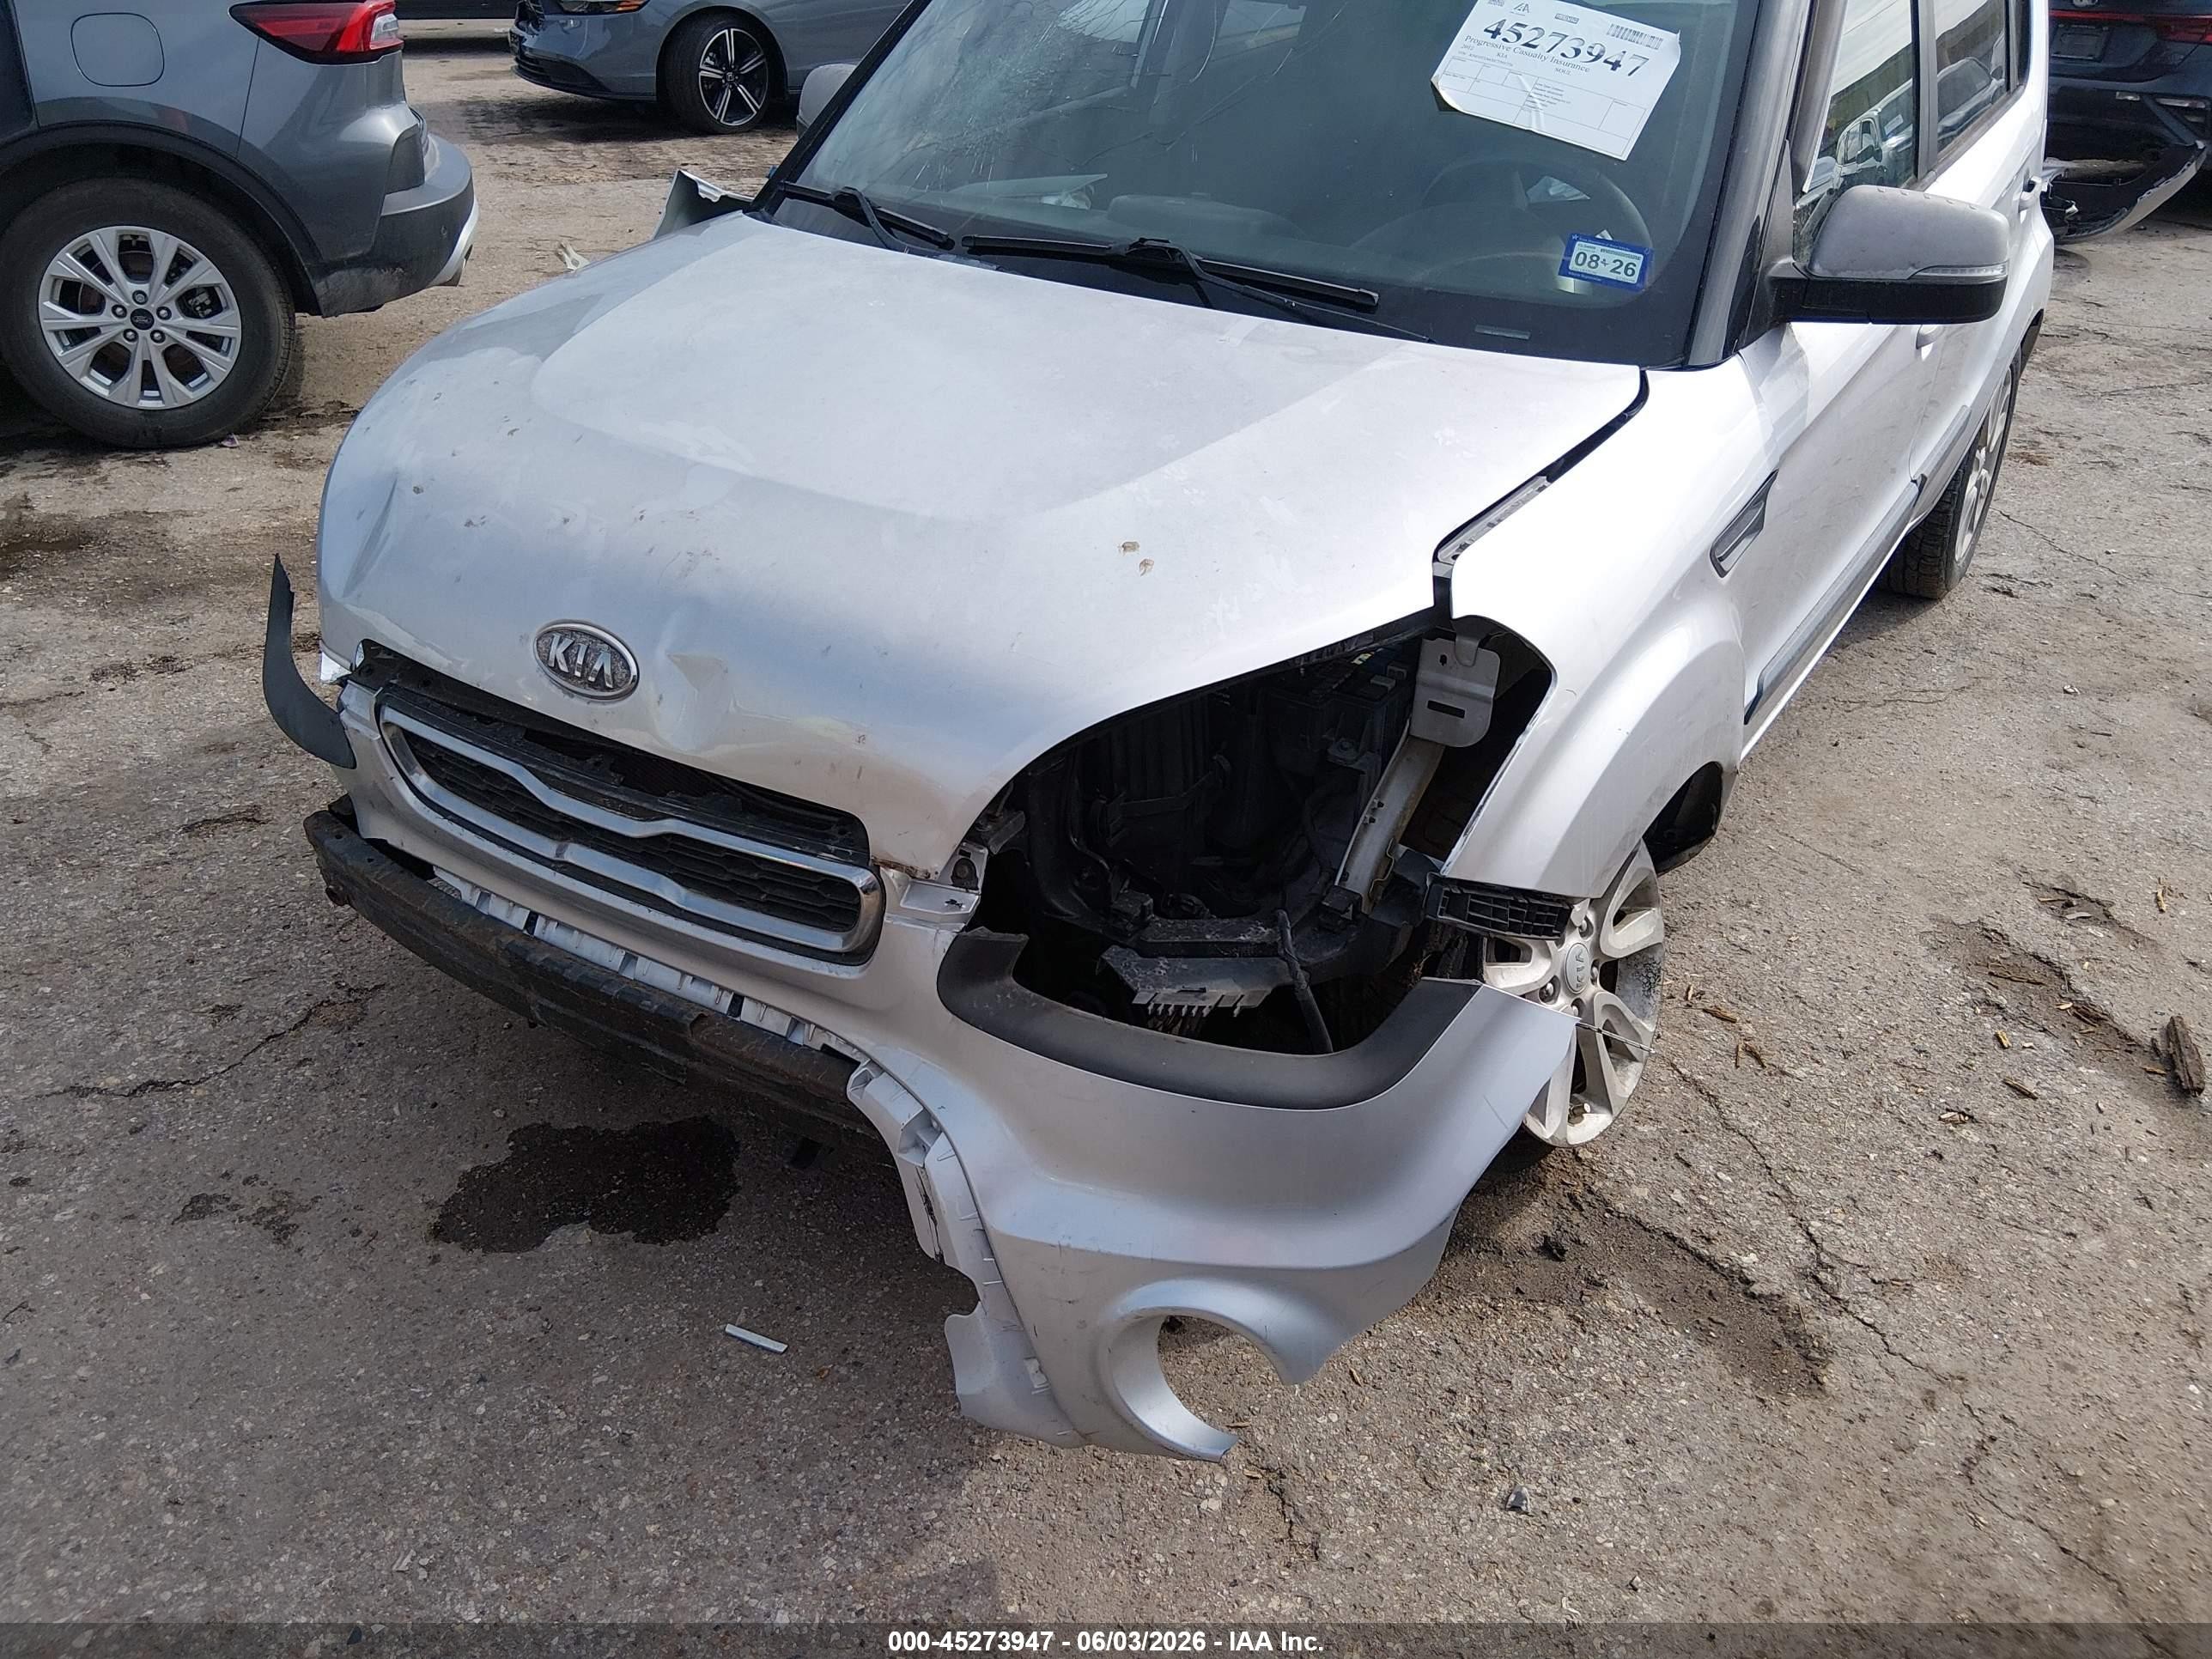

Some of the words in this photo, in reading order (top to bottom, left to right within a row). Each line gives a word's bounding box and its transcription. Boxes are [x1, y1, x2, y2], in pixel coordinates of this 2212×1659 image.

[1465, 35, 1511, 52] Progressive
[1513, 46, 1548, 63] Casualty
[1550, 56, 1590, 72] Insurance
[1484, 19, 1650, 76] 45273947
[1575, 252, 1600, 270] 08
[1610, 259, 1637, 277] 26
[548, 632, 614, 689] KIA
